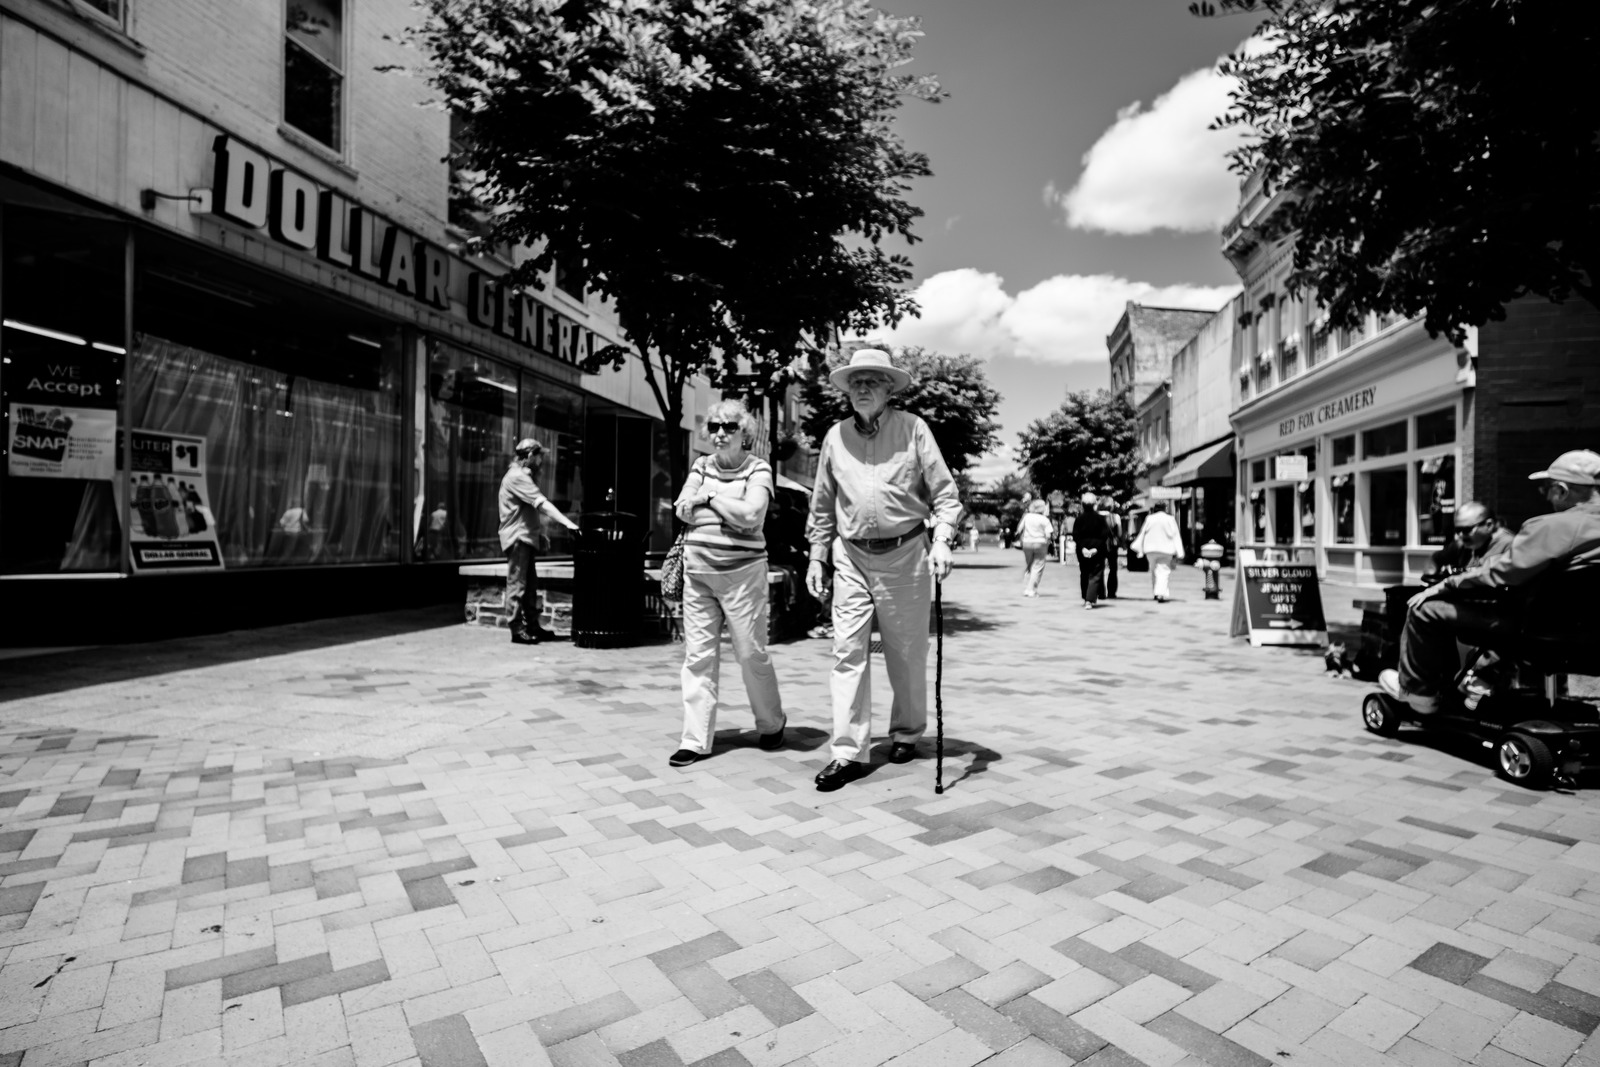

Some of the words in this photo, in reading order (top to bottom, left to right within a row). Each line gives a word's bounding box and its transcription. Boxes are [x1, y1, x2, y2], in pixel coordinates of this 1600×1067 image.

[213, 135, 450, 309] DOLLAR
[47, 363, 81, 379] WE
[27, 377, 102, 397] Accept
[1280, 419, 1295, 436] RED
[1298, 411, 1315, 431] FOX
[1318, 386, 1377, 423] CREAMERY
[14, 434, 66, 450] SNAP
[132, 439, 171, 452] LITER
[1248, 567, 1280, 578] SILVER
[1281, 568, 1312, 578] CLOUD
[1260, 583, 1303, 593] JEWELRY
[1275, 603, 1294, 614] ART
